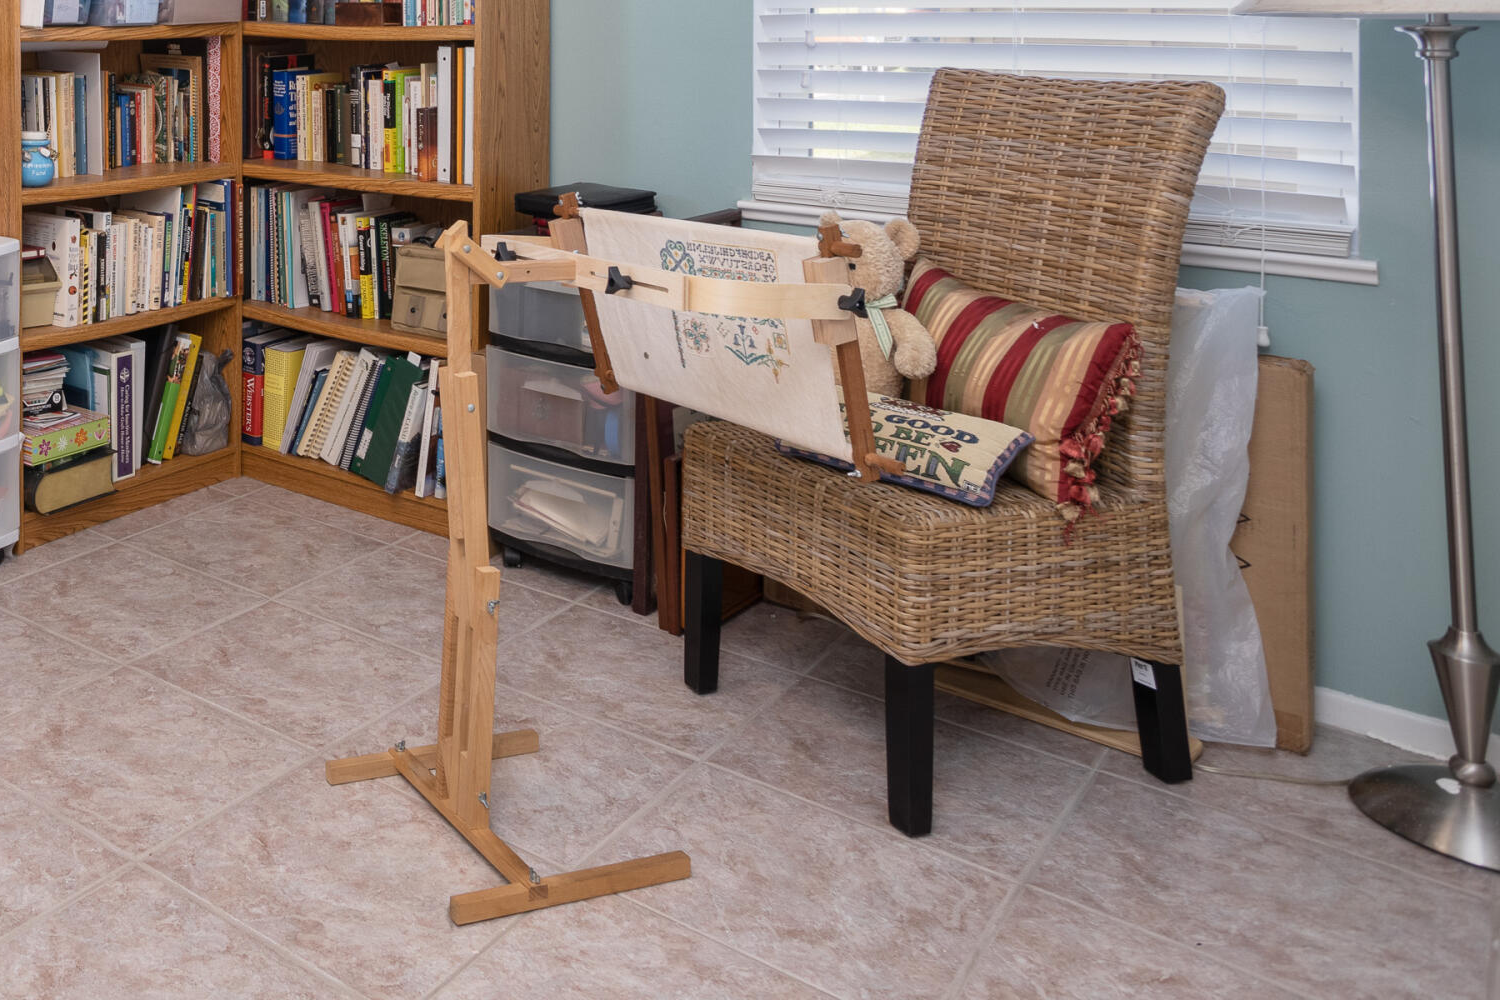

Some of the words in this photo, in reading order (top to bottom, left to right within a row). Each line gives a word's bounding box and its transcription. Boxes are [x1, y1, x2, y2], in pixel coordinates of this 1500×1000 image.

[379, 222, 390, 261] SKELETON
[884, 414, 979, 444] GOOD
[889, 425, 935, 446] BE
